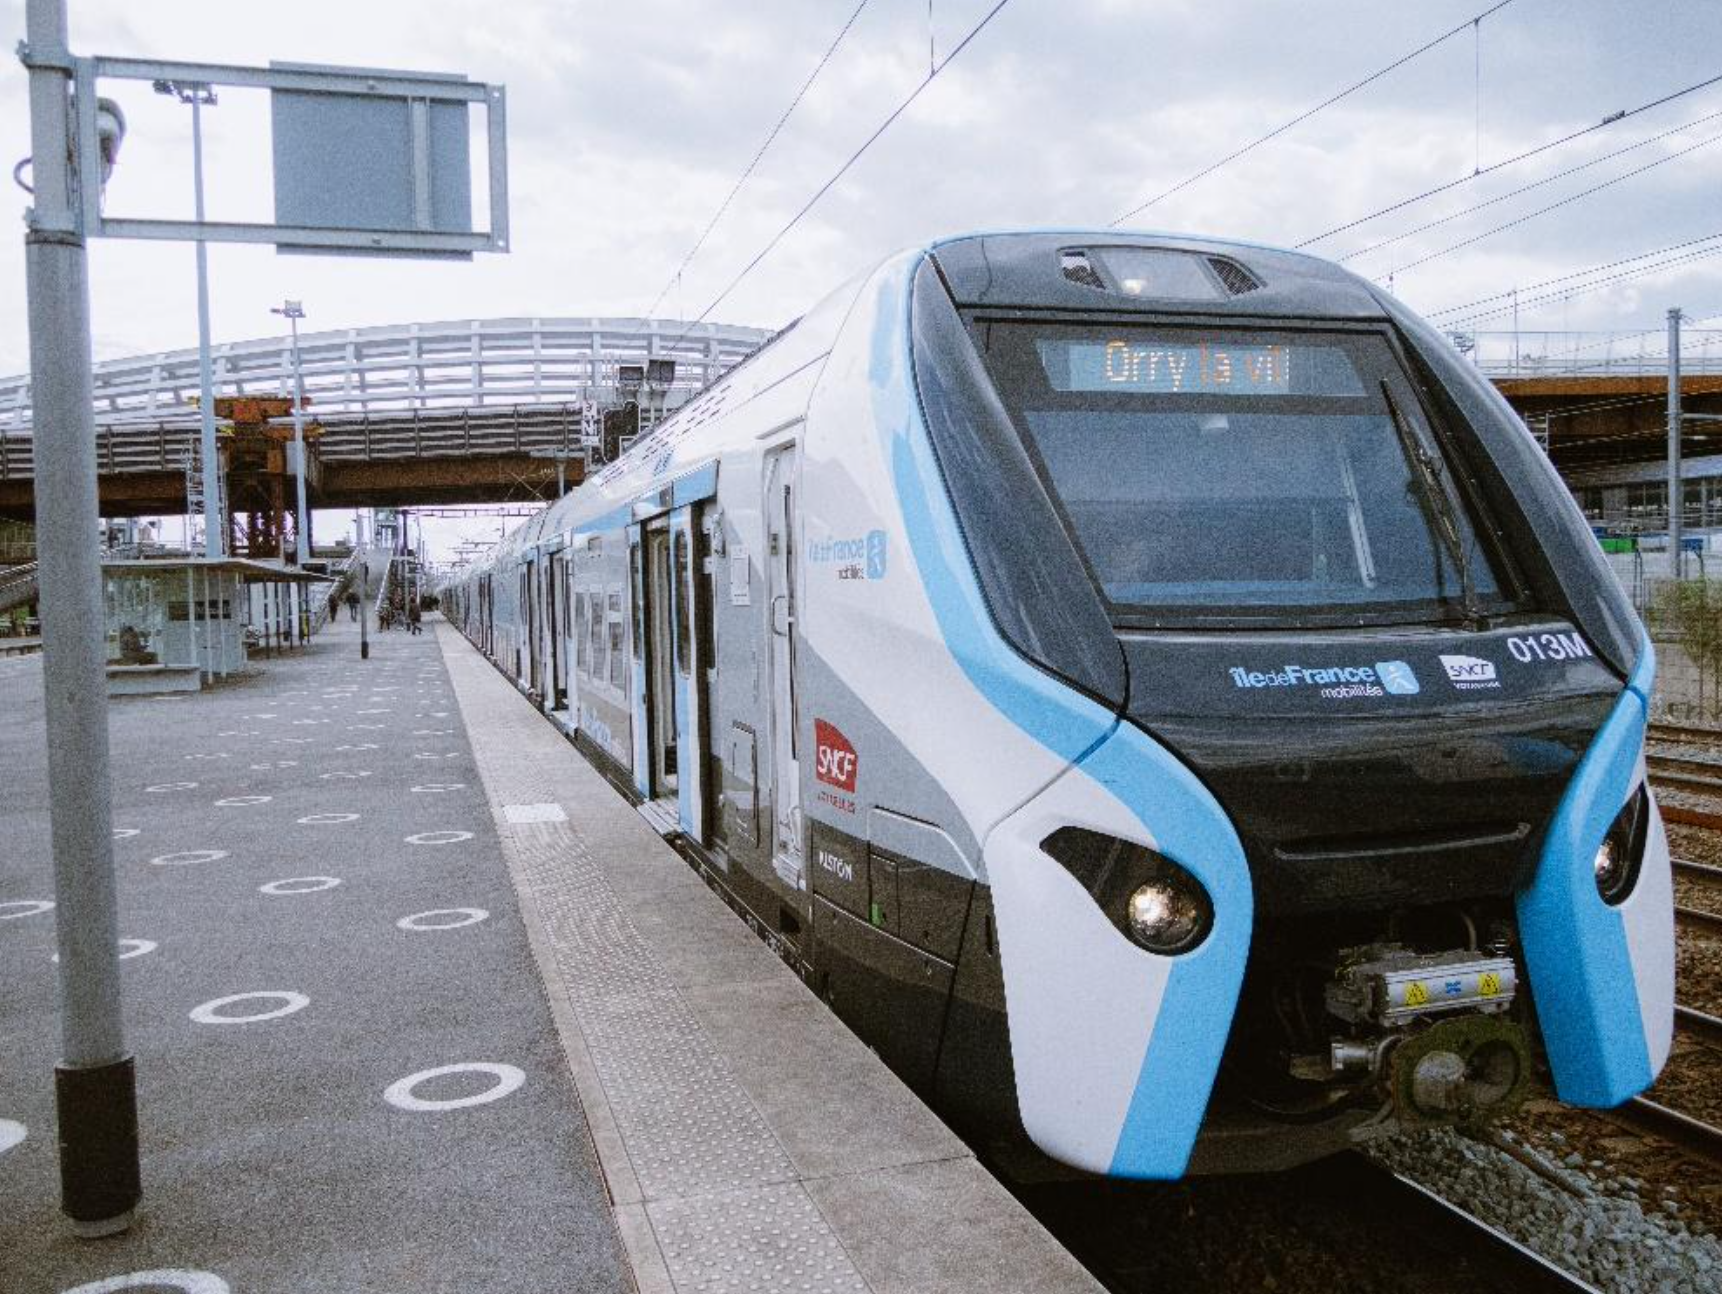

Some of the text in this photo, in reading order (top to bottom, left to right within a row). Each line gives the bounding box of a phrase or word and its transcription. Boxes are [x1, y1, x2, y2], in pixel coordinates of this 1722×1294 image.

[1105, 340, 1187, 392] Orry
[1201, 340, 1230, 386] la
[1507, 632, 1593, 663] 013M
[817, 744, 856, 781] SNCF
